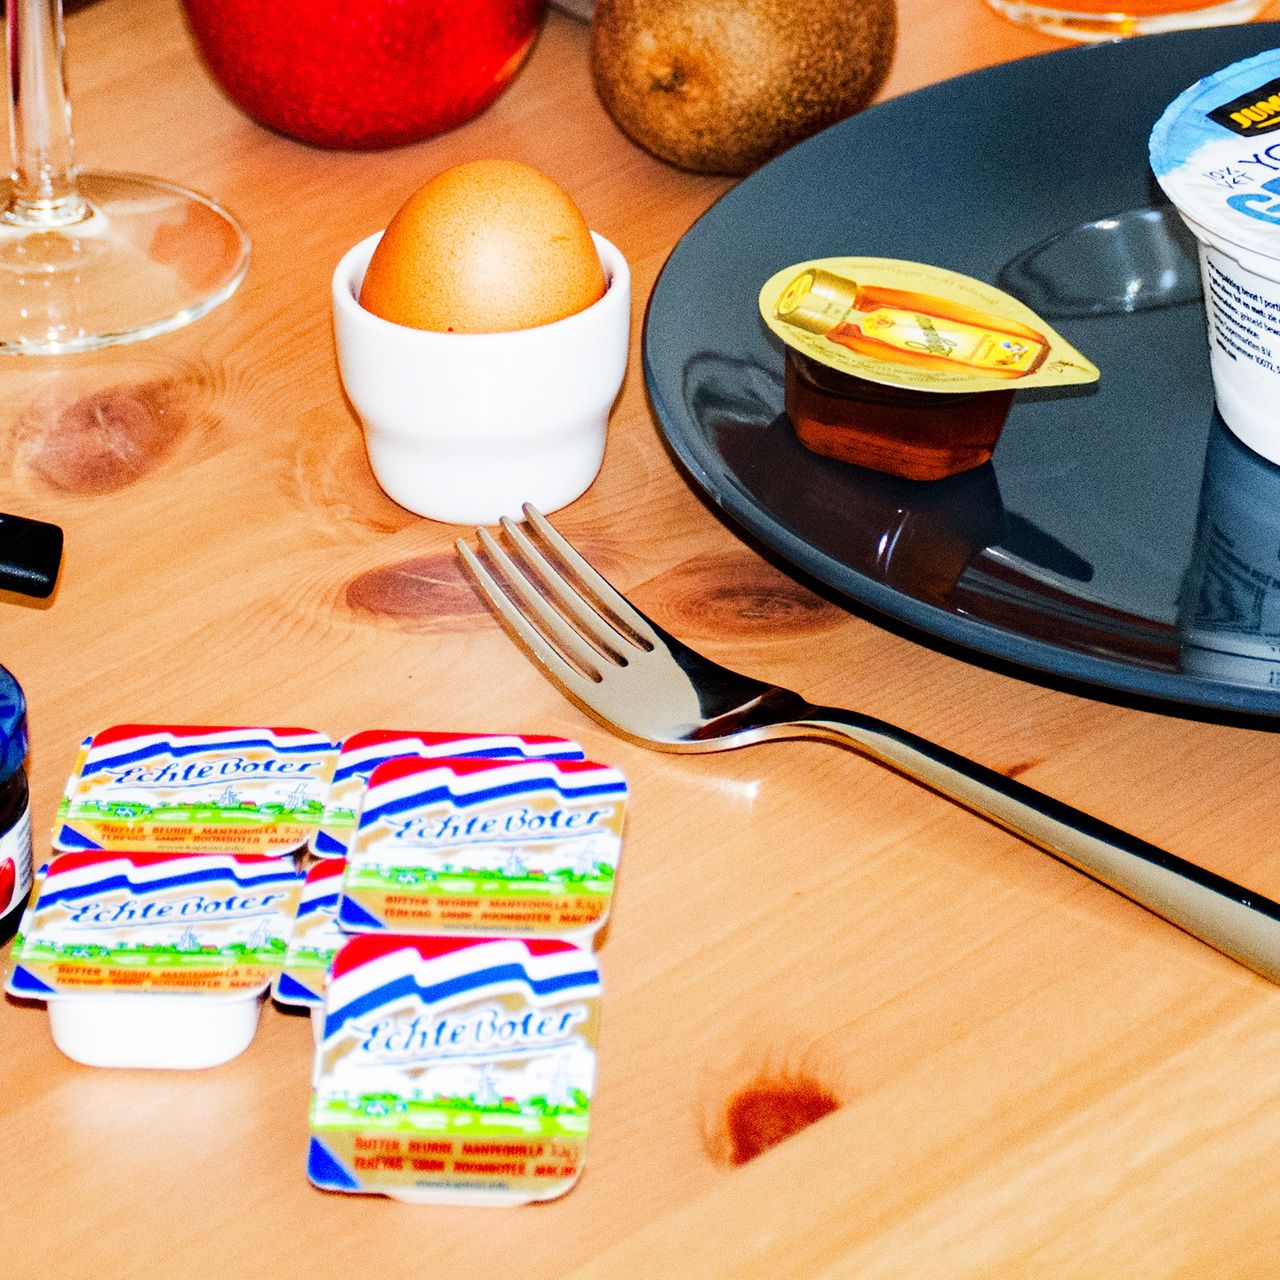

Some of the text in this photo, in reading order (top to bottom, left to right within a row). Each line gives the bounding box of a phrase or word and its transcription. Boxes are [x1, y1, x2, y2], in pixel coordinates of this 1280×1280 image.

[106, 756, 322, 784] Echte Boter
[102, 824, 145, 835] BUTTER
[152, 825, 195, 836] BEURRE
[387, 807, 610, 839] Echte Boter
[65, 893, 286, 922] Echte Boter
[384, 895, 430, 906] BUTTER
[355, 1008, 581, 1051] Echte Boter
